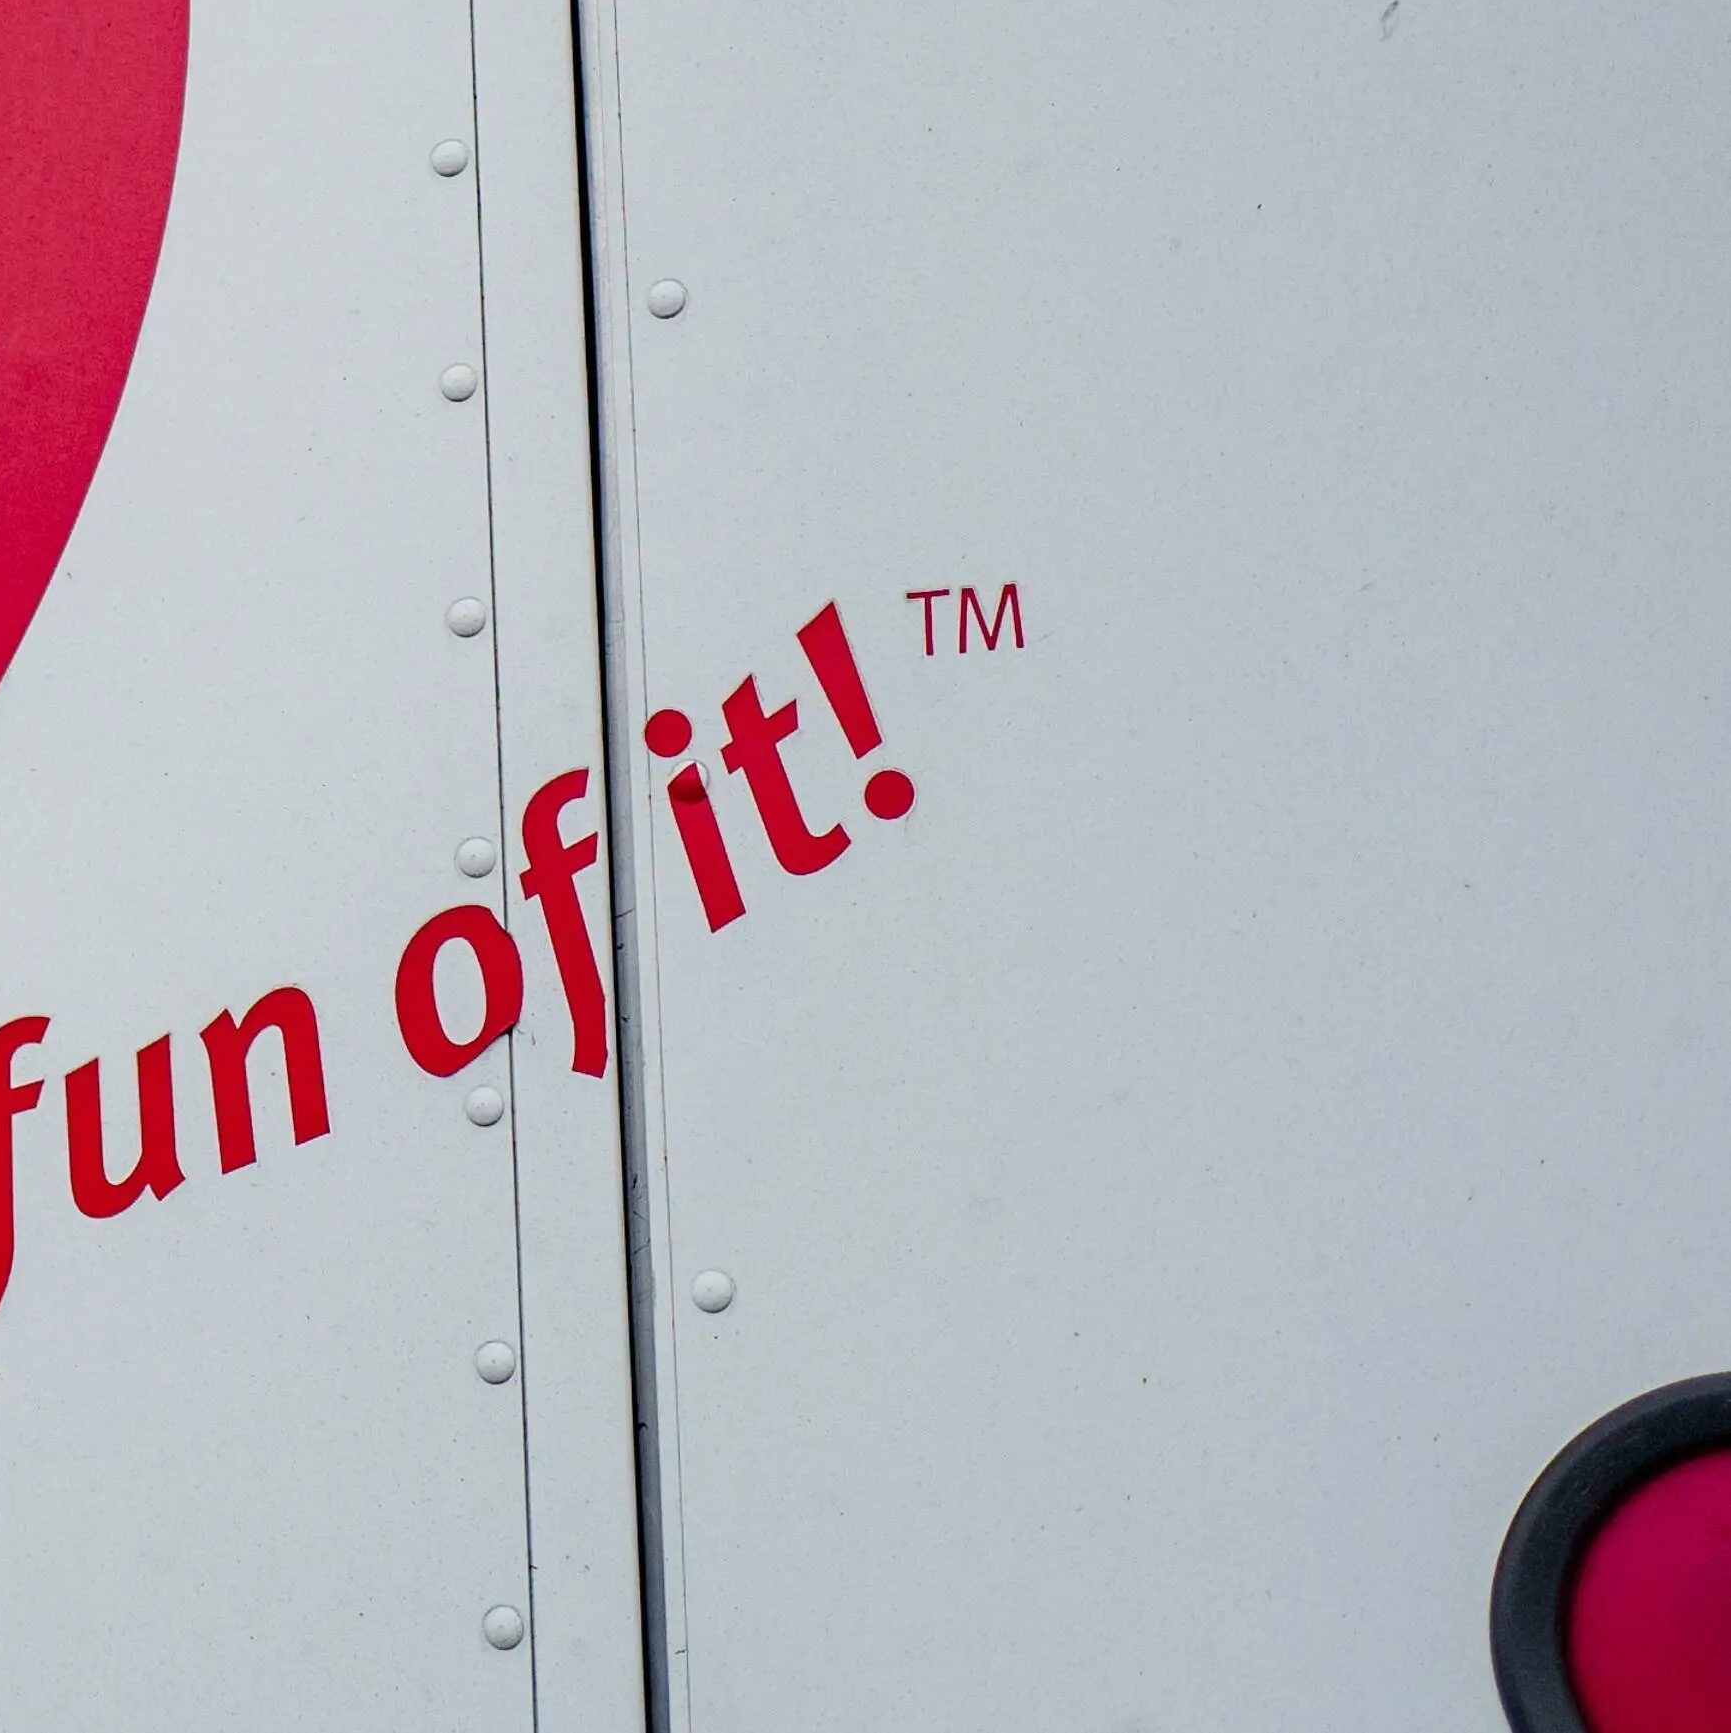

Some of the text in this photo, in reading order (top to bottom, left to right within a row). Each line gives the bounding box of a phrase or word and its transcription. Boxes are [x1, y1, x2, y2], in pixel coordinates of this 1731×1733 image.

[394, 768, 609, 1079] of
[642, 599, 916, 935] it!
[905, 582, 1025, 657] TM
